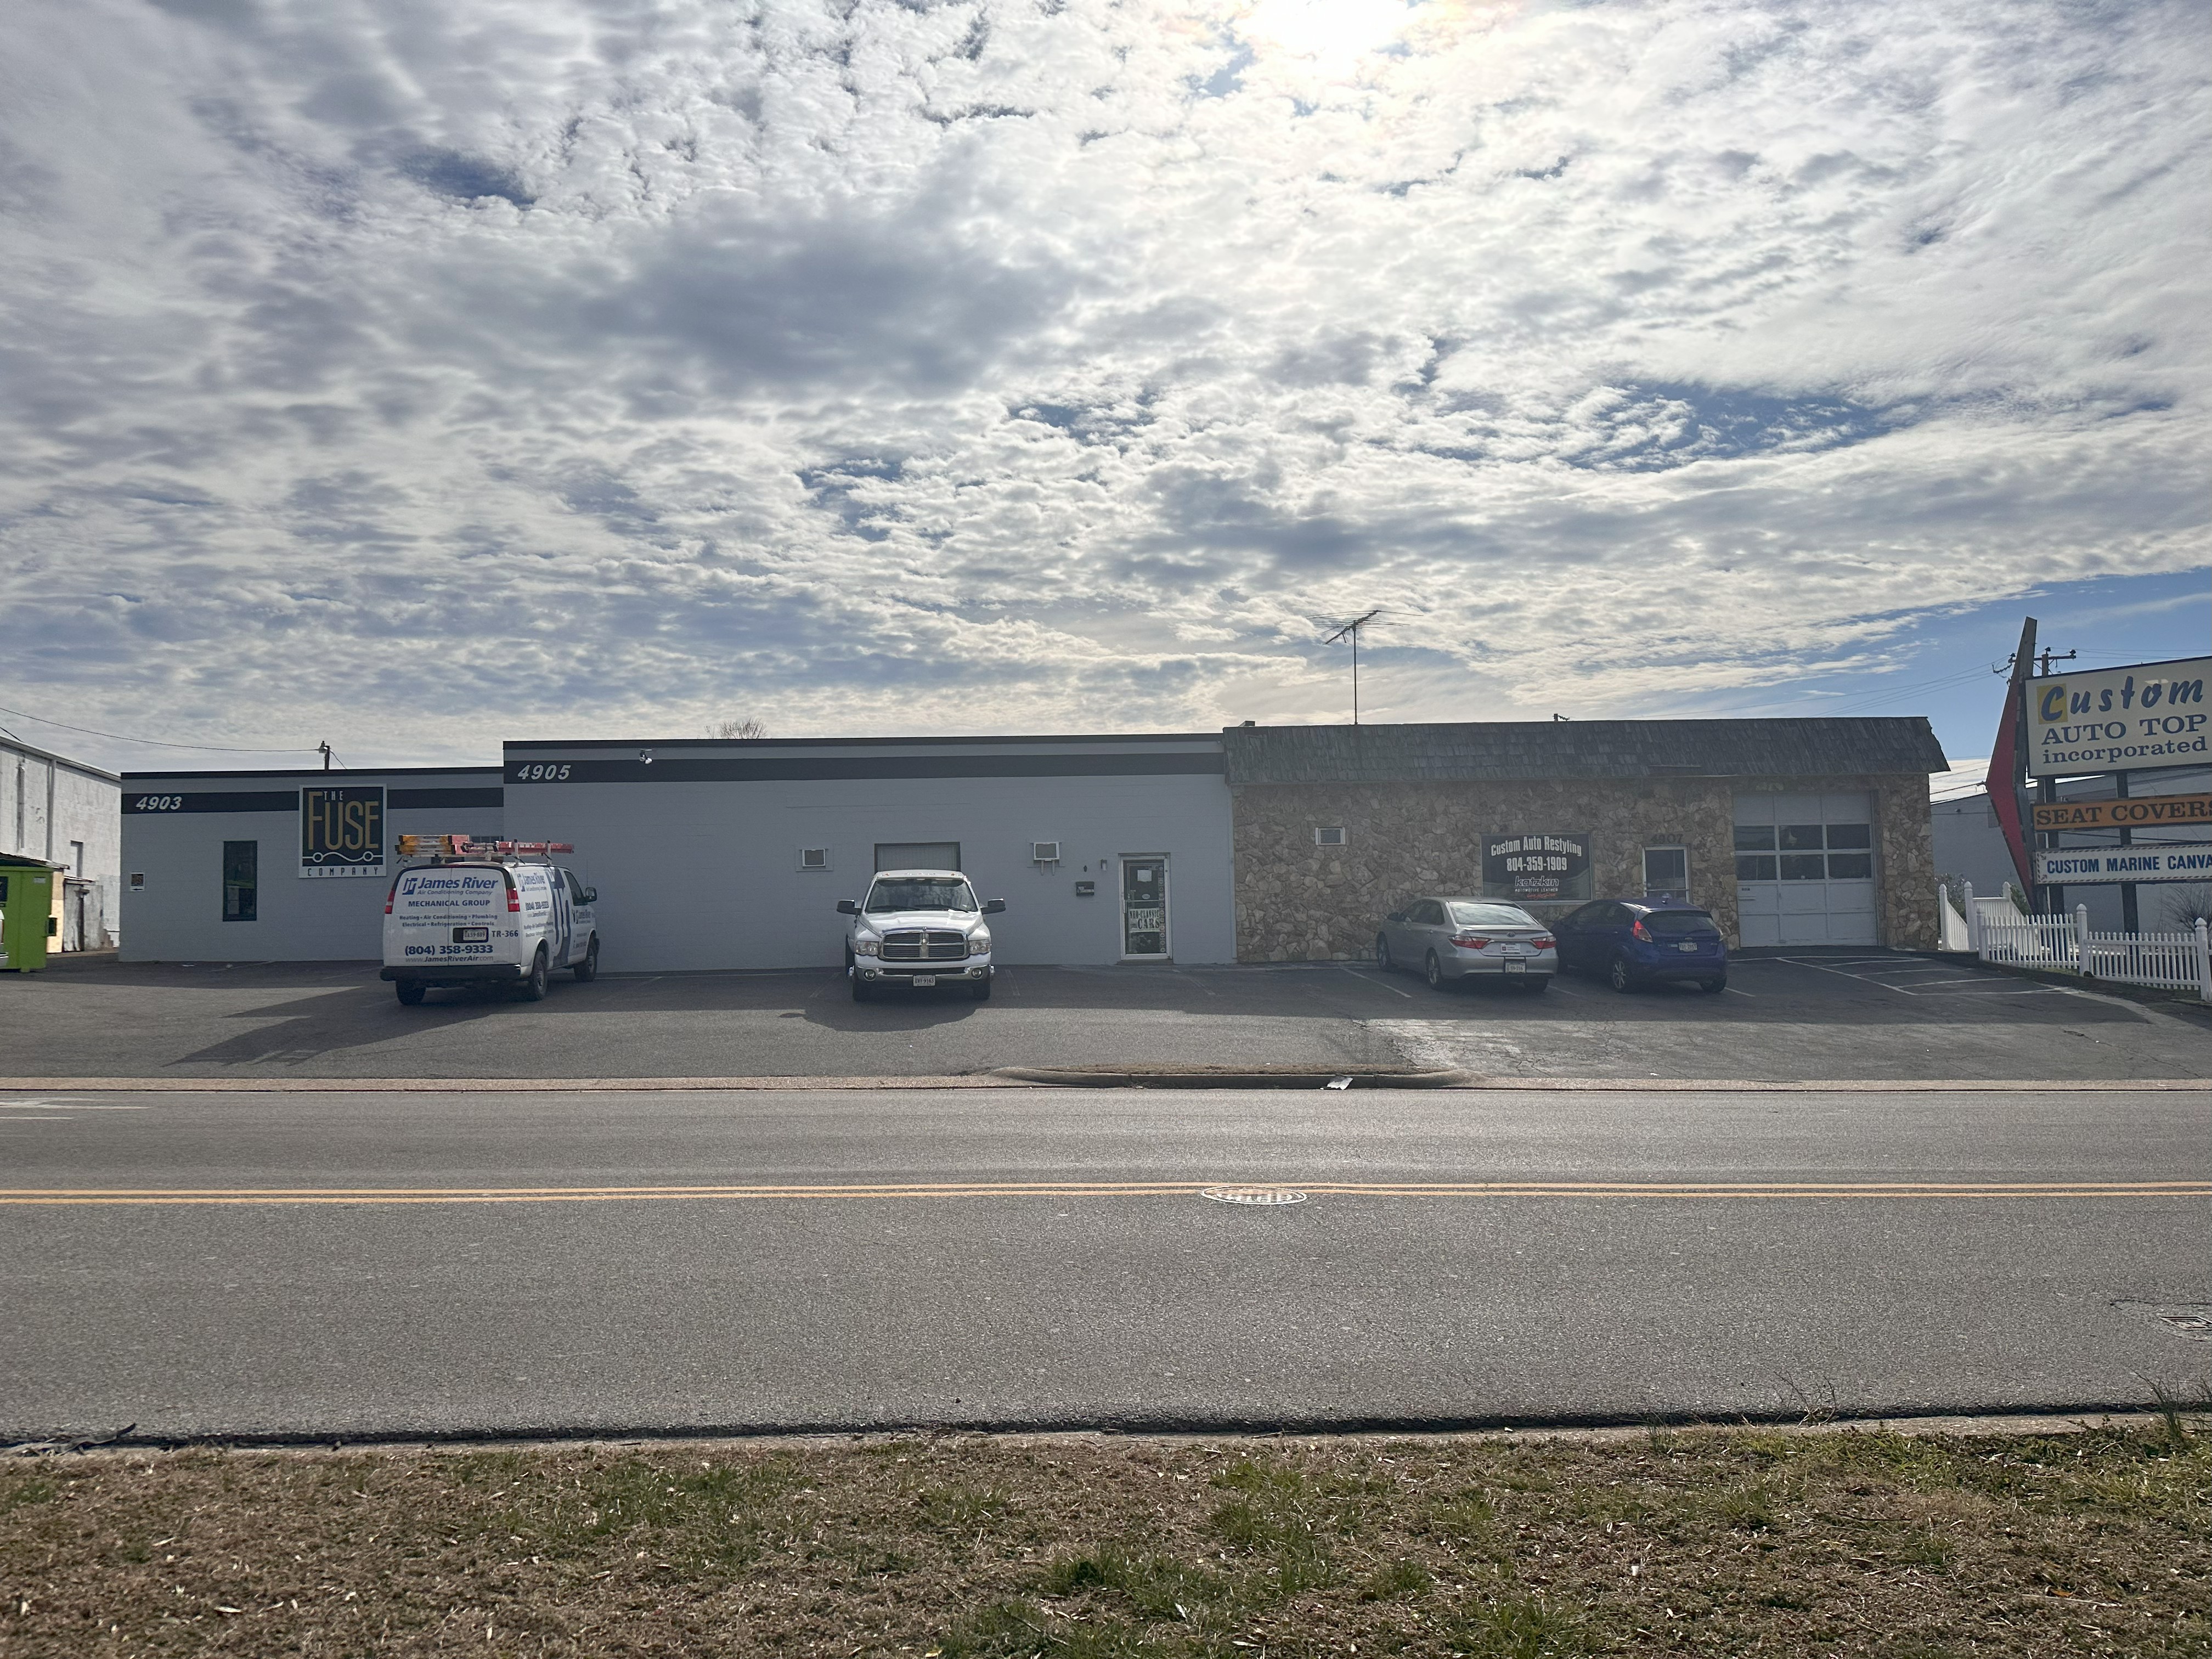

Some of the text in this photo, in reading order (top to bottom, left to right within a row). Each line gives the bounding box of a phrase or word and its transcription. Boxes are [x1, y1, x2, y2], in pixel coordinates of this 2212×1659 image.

[2041, 675, 2203, 721] Custom
[2041, 714, 2207, 745] AUTO TOP
[2043, 736, 2208, 764] incorporated
[518, 765, 571, 780] 4905
[136, 796, 182, 810] 4903
[324, 791, 343, 801] THE
[2036, 800, 2212, 825] SEAT COVER
[308, 791, 379, 850] FUSE
[1651, 833, 1683, 843] 4907
[1491, 836, 1582, 856] Custom Auto Restyling
[307, 866, 378, 876] COMPANY
[1506, 856, 1567, 871] 804-359-1909
[2047, 858, 2100, 874] CUSTOM
[2107, 856, 2160, 872] MARINE
[417, 877, 499, 889] James River
[1515, 876, 1559, 886] katzkin
[1137, 918, 1160, 929] CARS
[405, 945, 493, 956] (804) 358-9333
